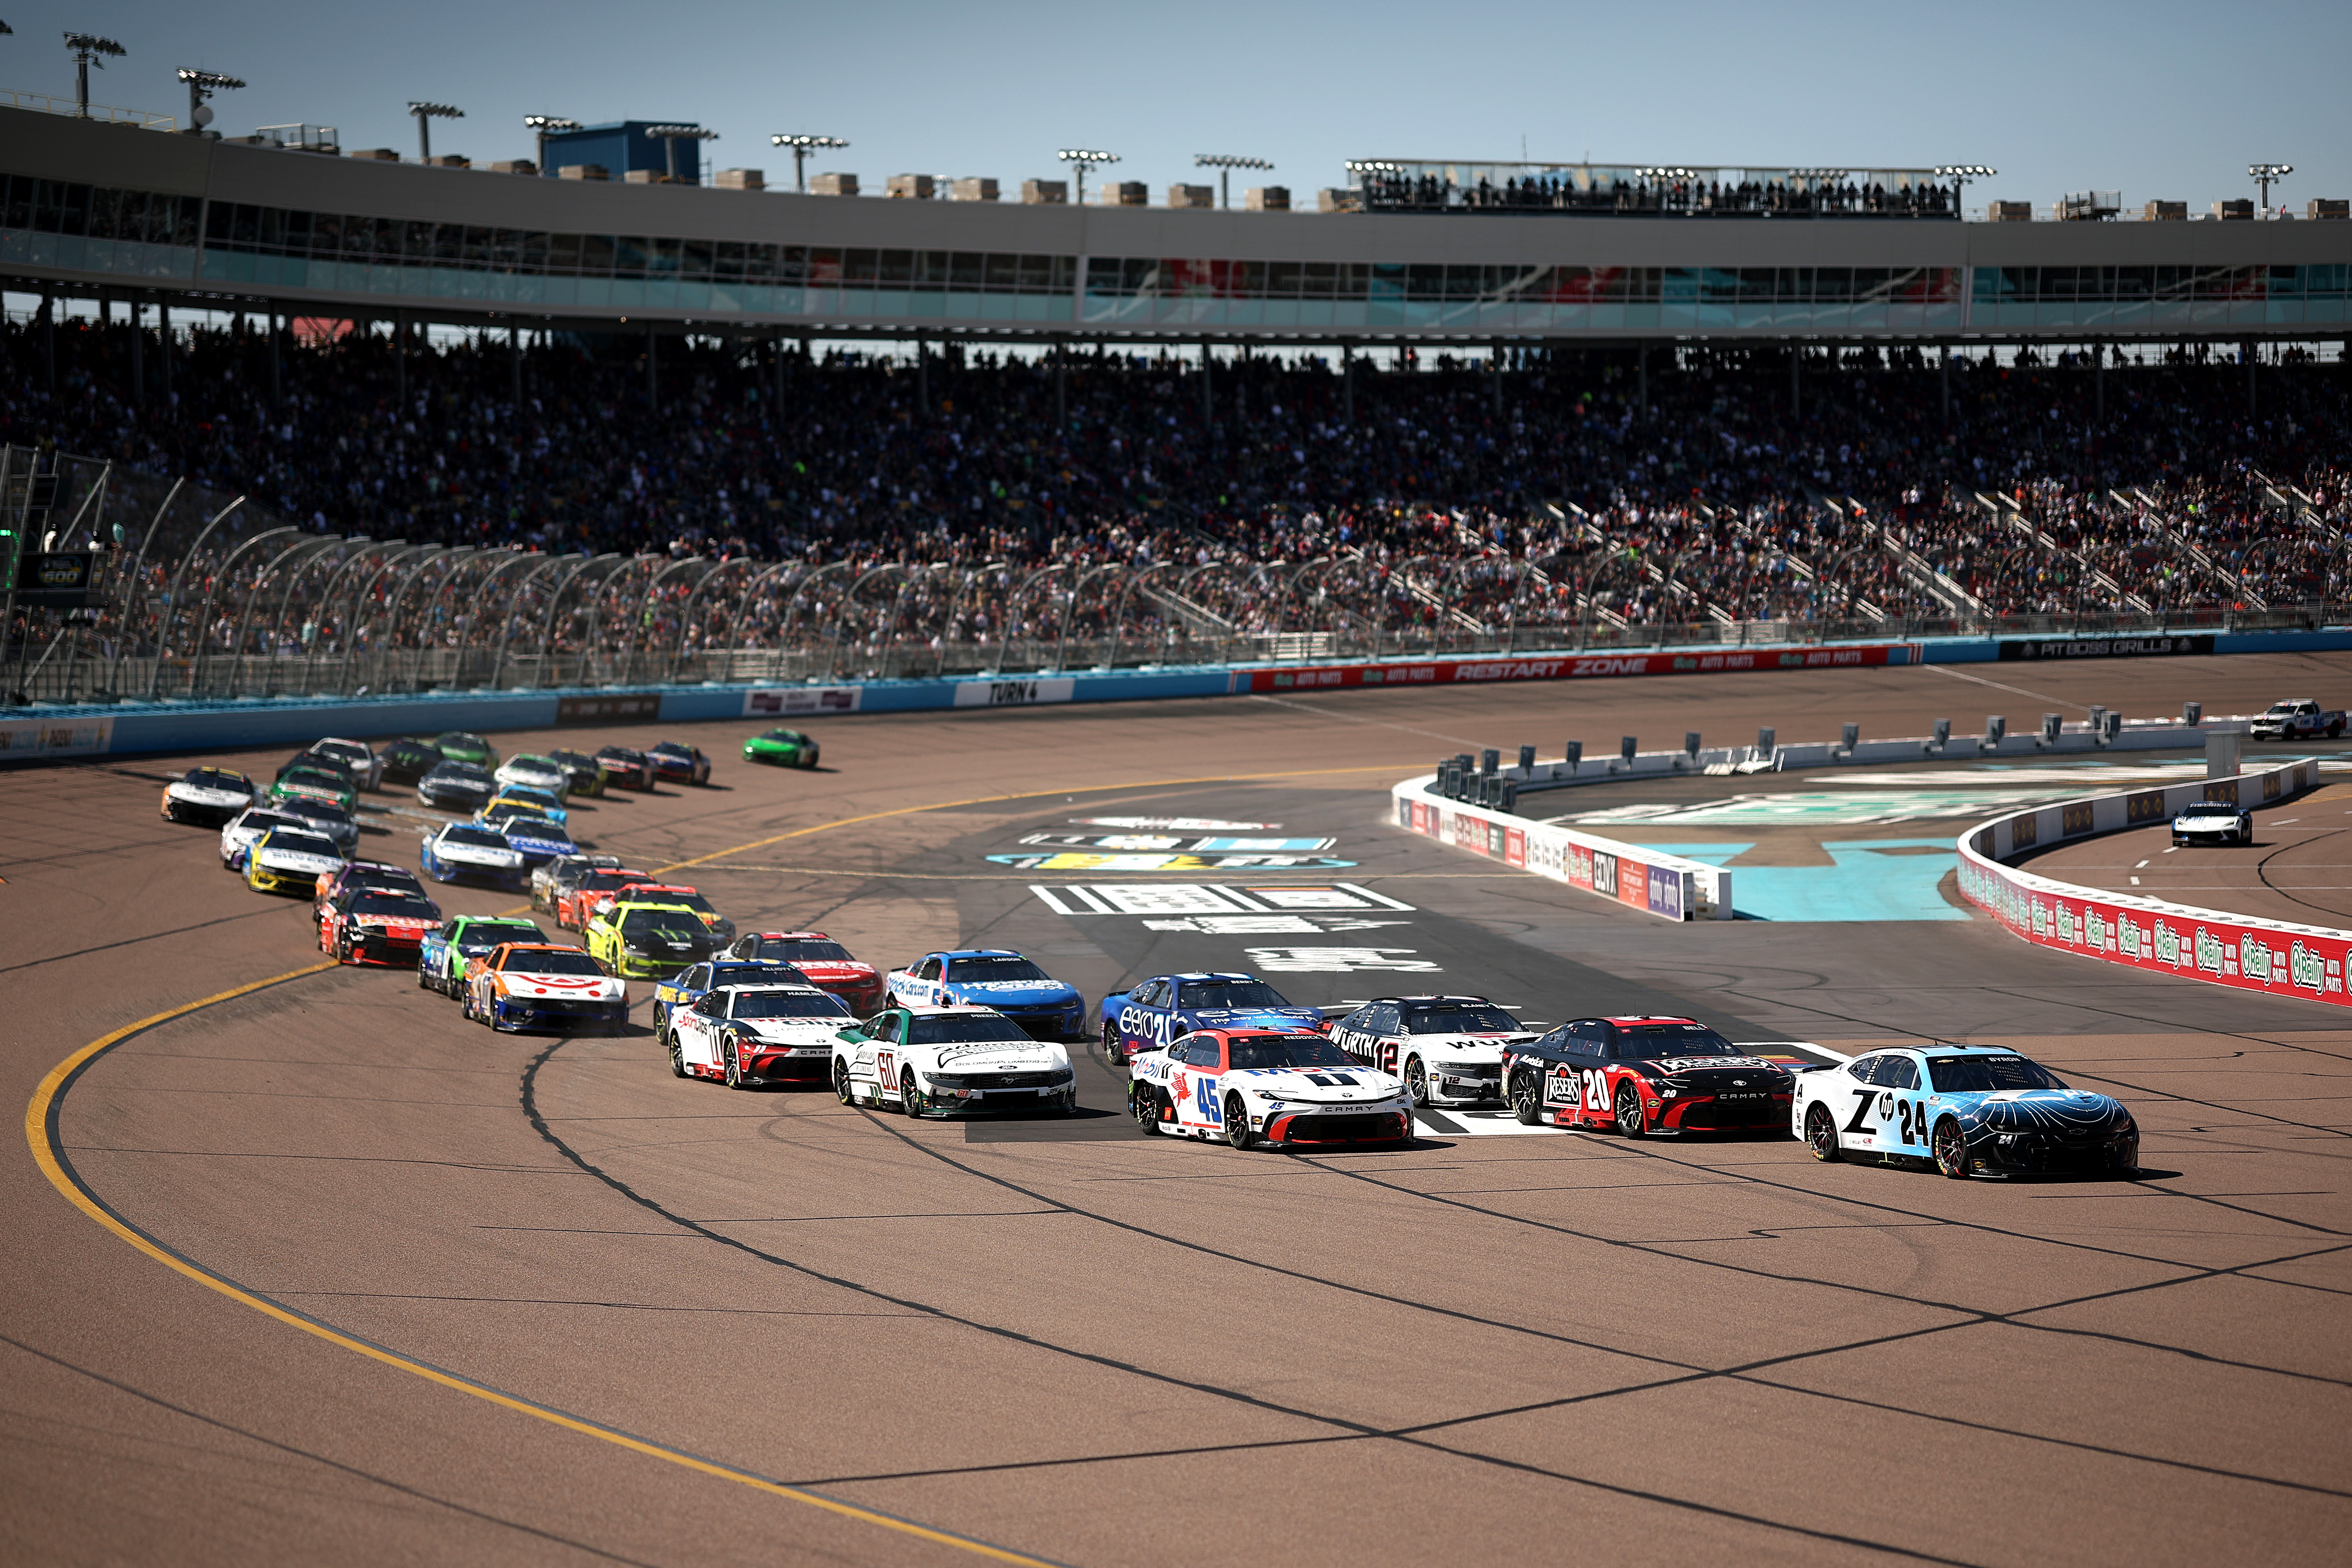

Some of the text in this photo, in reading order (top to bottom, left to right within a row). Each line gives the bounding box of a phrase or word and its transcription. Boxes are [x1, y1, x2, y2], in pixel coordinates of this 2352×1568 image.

[2041, 639, 2172, 656] PIT BOSS GRILLS
[1808, 652, 1831, 665] AUTO
[1833, 651, 1862, 664] PARTS
[1455, 658, 1649, 680] RESTART ZONE
[990, 682, 1038, 704] TURN 4
[2086, 908, 2105, 952] O'Reilly
[2106, 922, 2115, 937] AUTO
[2119, 915, 2140, 959] O'Reilly
[2142, 929, 2151, 944] AUTO
[2105, 937, 2116, 952] PARTS
[2141, 944, 2153, 959] PARTS
[2155, 921, 2179, 967] O'Reilly
[2181, 936, 2192, 952] AUTO
[2196, 929, 2223, 976] O'Reilly
[2225, 944, 2237, 959] AUTO
[2180, 952, 2193, 968] PARTS
[2224, 960, 2238, 976] PARTS
[2241, 935, 2271, 984] O'Reilly
[2273, 951, 2286, 967] AUTO
[2291, 943, 2324, 993] O'Reilly
[2327, 959, 2340, 976] AUTO
[2272, 967, 2287, 984] PARTS
[2326, 976, 2342, 994] PARTS
[1196, 1008, 1313, 1018] eero
[1119, 1006, 1154, 1039] eero
[1153, 1013, 1172, 1047] 21
[753, 1045, 767, 1053] 11
[1328, 1025, 1375, 1057] WÜRTH
[1134, 1056, 1164, 1078] Mobil
[1375, 1041, 1399, 1078] 12
[878, 1052, 899, 1091] 60
[1316, 1073, 1344, 1085] 1
[1448, 1076, 1461, 1084] 12
[1548, 1076, 1580, 1101] RESER'S
[1582, 1068, 1611, 1111] 20
[1662, 1090, 1677, 1098] 20
[1197, 1077, 1223, 1123] 45
[1268, 1102, 1285, 1110] 45
[1880, 1093, 1894, 1121] hp
[1841, 1089, 1881, 1136] Z
[1896, 1097, 1930, 1148] 24
[1998, 1135, 2013, 1144] 24
